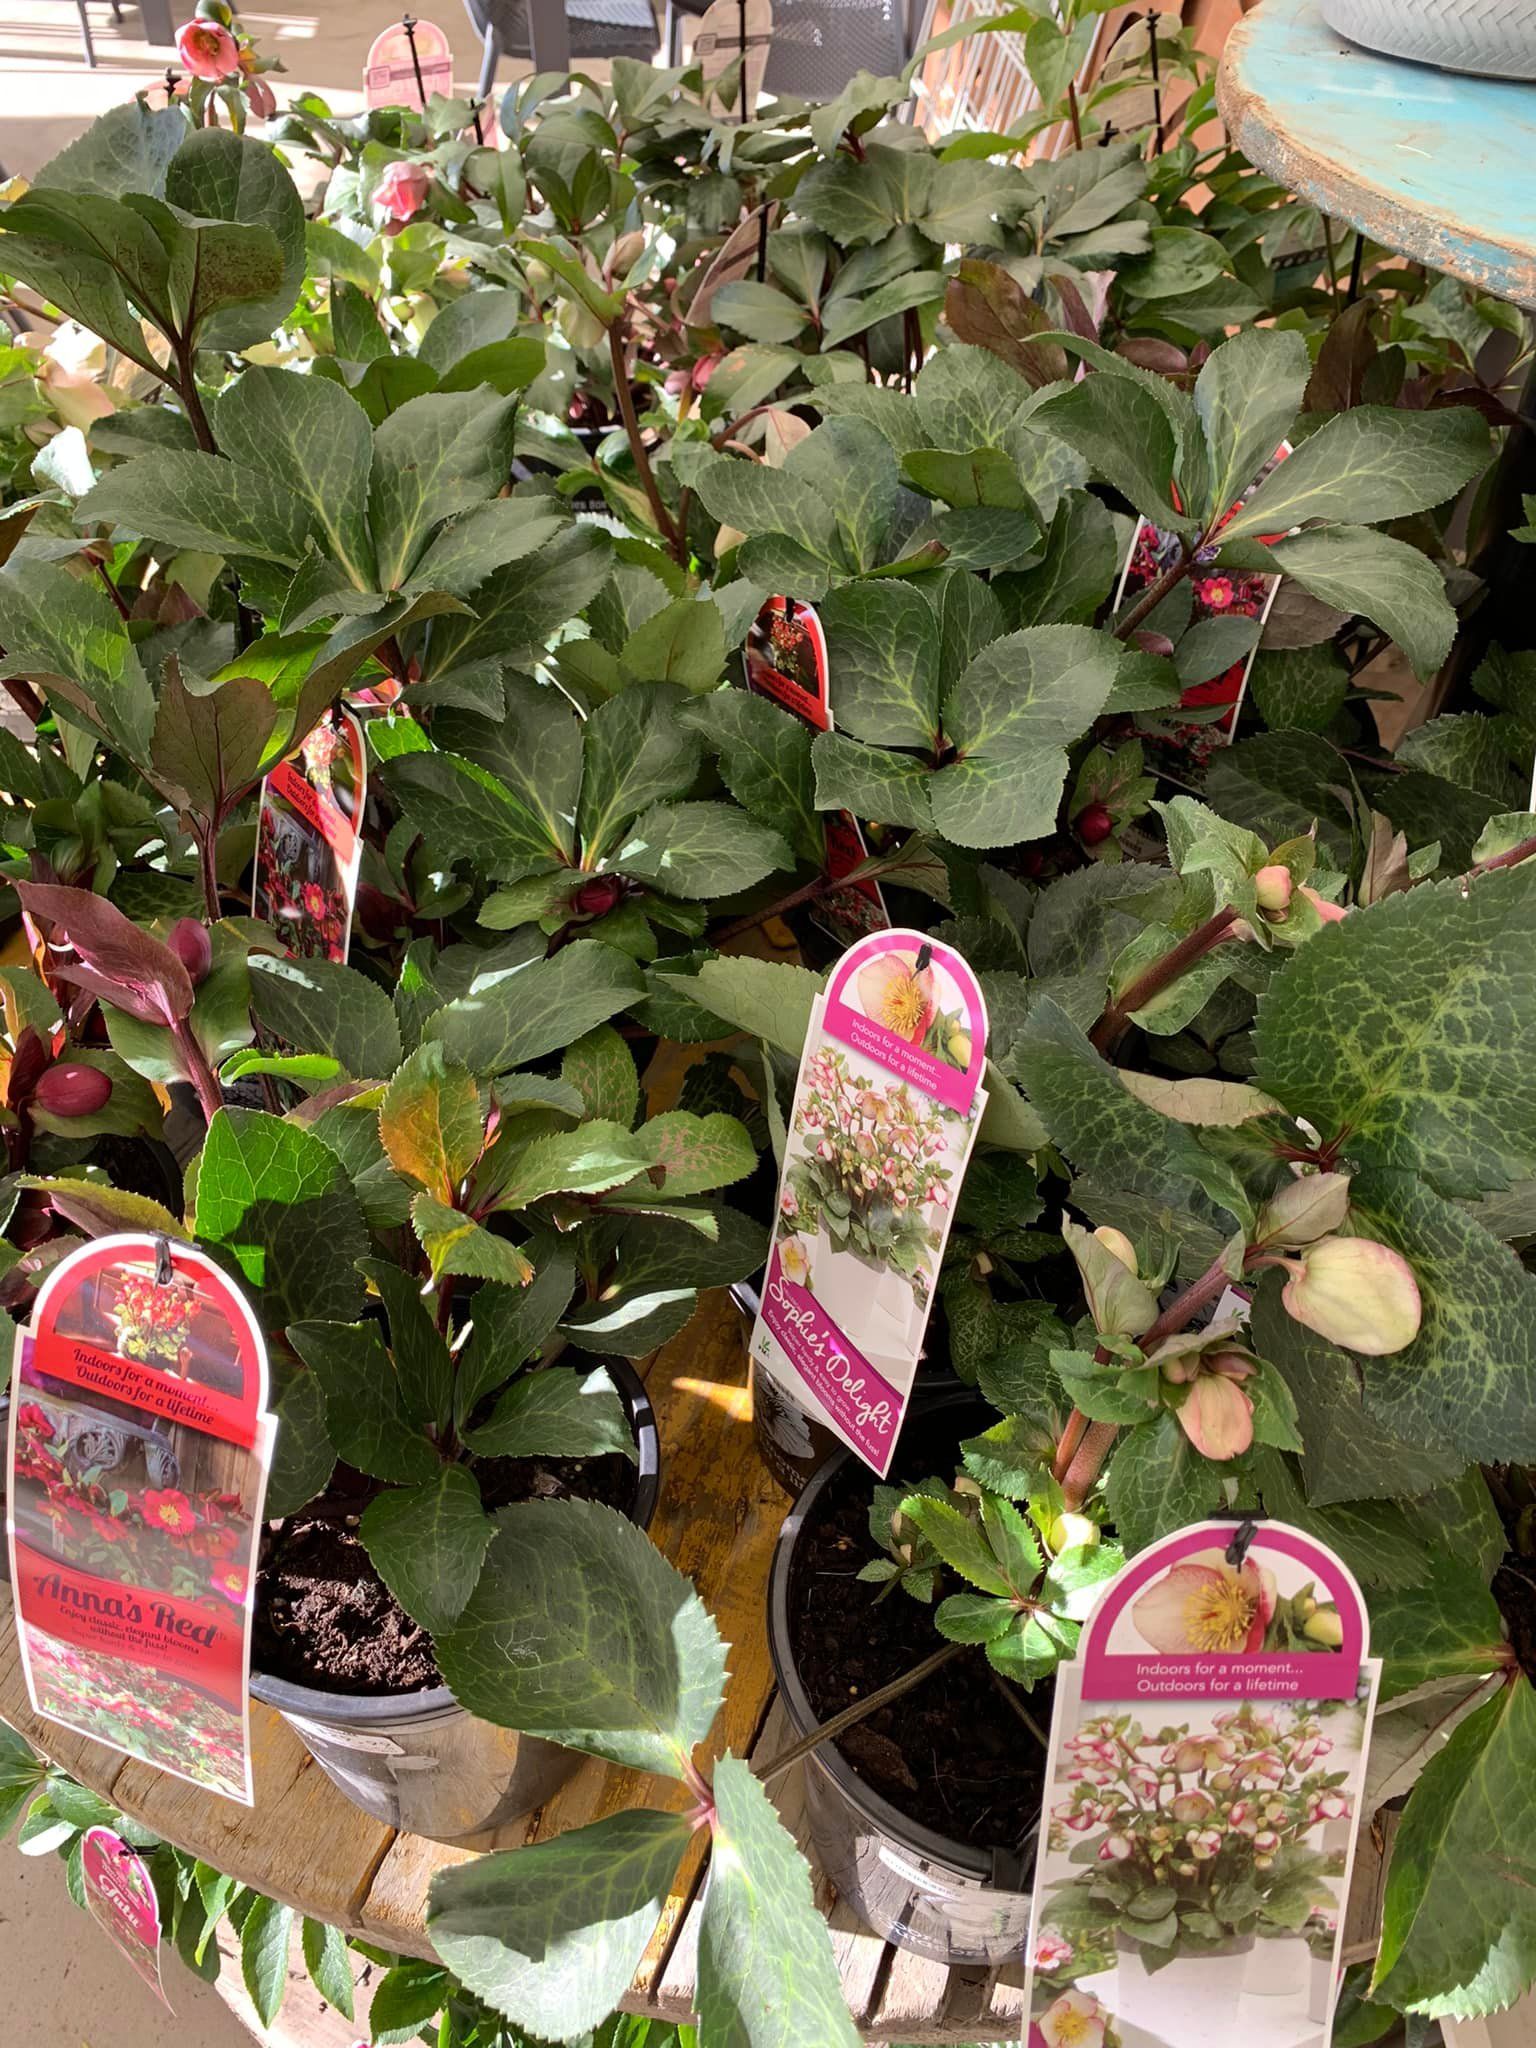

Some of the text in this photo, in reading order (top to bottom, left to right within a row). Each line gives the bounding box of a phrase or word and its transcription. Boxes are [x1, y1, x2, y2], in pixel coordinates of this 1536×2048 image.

[850, 1032, 886, 1060] Outdoors
[888, 1053, 899, 1067] for
[906, 1066, 937, 1090] lifetime
[852, 1019, 880, 1042] Indoors
[882, 1036, 894, 1048] for
[901, 1049, 941, 1078] moment...
[74, 1348, 122, 1376] Indoors
[121, 1366, 143, 1382] for
[145, 1377, 153, 1387] a
[769, 1276, 892, 1434] Sophie's Delight
[76, 1366, 214, 1425] Outdoors for a lifetime
[834, 1404, 855, 1431] without
[855, 1427, 865, 1442] the
[864, 1439, 880, 1457] fuss!
[33, 1572, 218, 1648] Anna's Red
[1136, 1662, 1303, 1675] Indoors for a moment...
[1136, 1678, 1299, 1692] Outdoors for a lifetime
